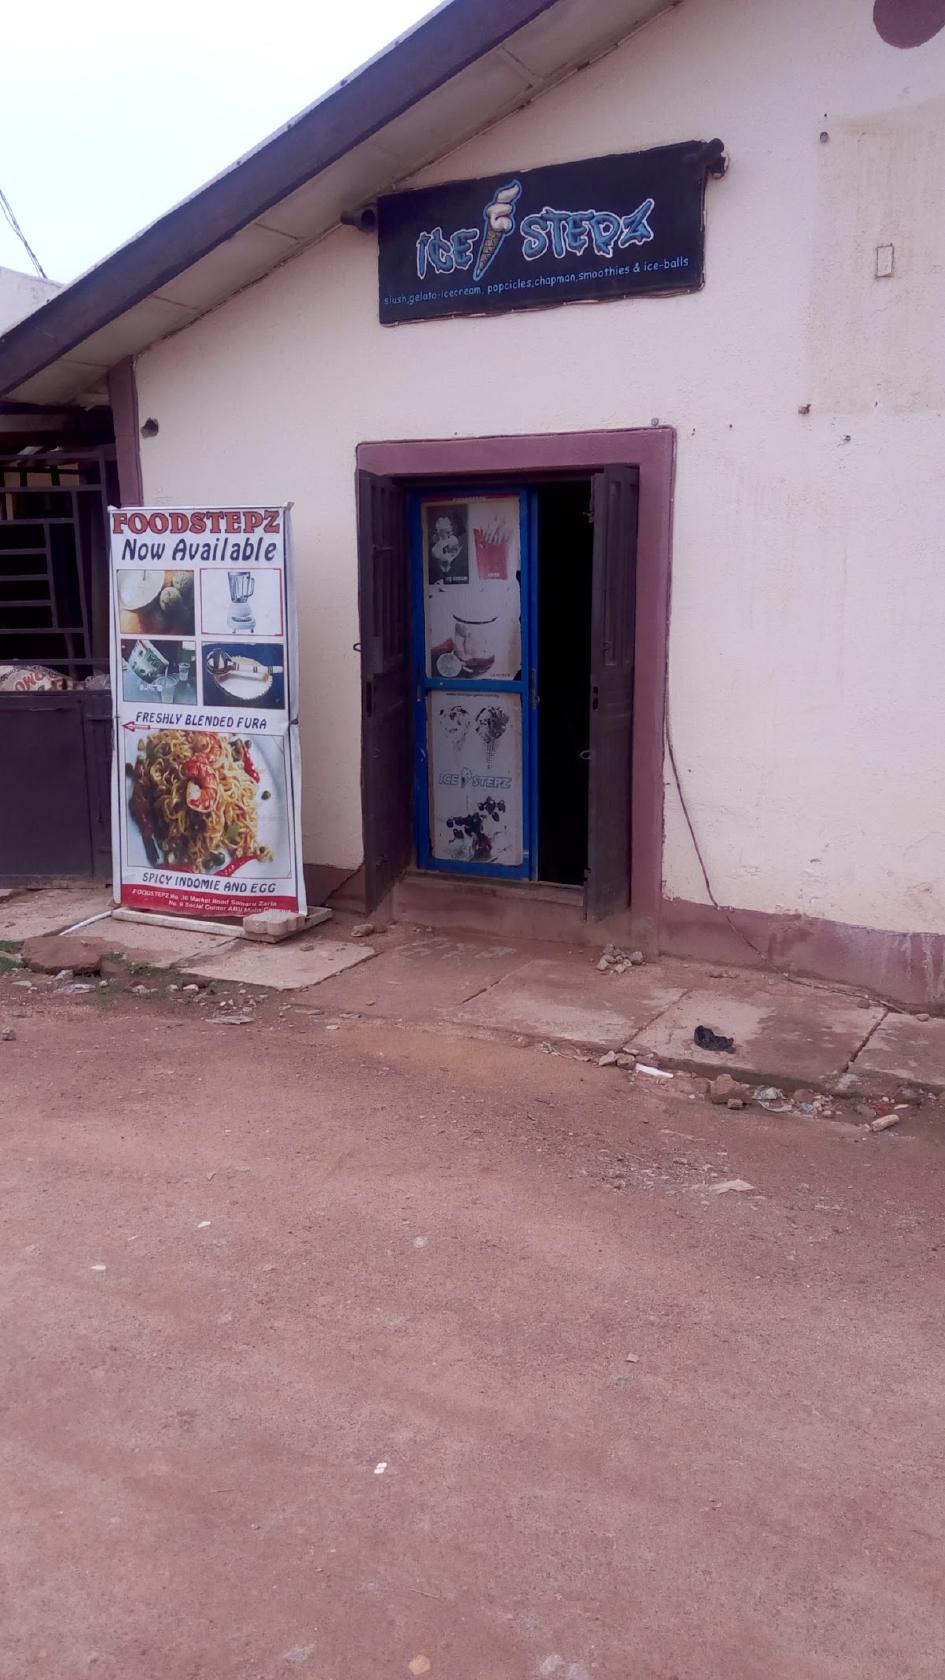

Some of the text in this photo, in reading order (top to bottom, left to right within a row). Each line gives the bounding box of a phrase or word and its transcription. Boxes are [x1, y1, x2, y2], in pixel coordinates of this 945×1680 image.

[416, 198, 655, 280] ICE STEPZ
[632, 262, 641, 273] &
[643, 256, 689, 271] ice-balls
[112, 510, 280, 534] FOODSTEPZ
[121, 537, 277, 561] Now Available
[135, 711, 267, 729] FRESHLY BLENDED FURA
[142, 872, 276, 893] SPICY INDOMIE AND EGG
